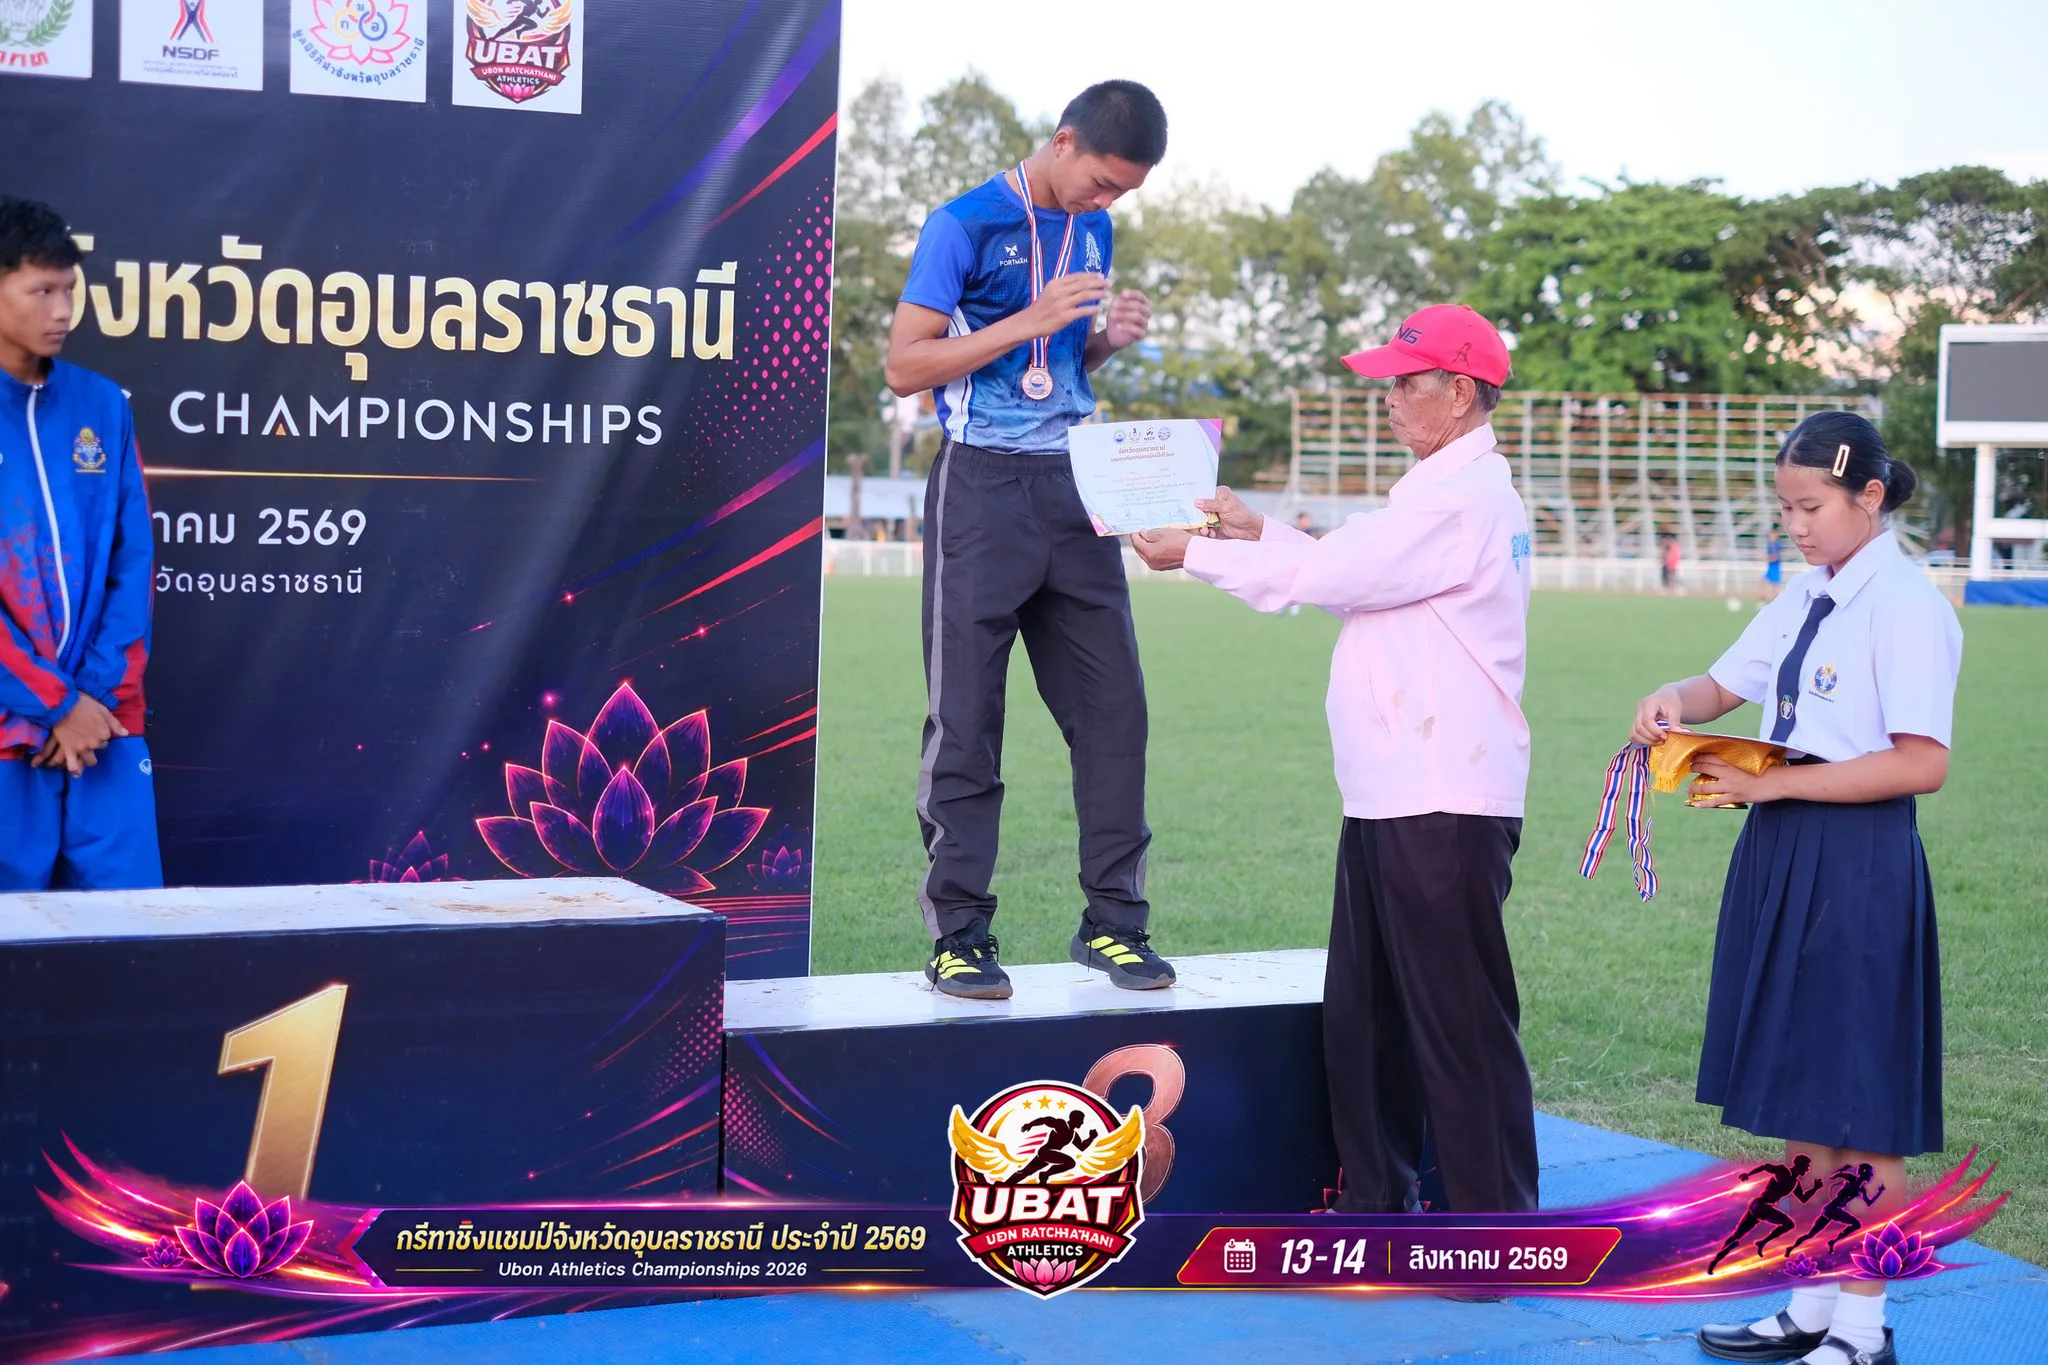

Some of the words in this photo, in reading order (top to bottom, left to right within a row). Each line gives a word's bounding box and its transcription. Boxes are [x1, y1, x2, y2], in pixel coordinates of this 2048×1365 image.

[162, 45, 220, 61] NSDF
[473, 39, 563, 69] UBAT
[481, 67, 504, 76] UBON
[505, 66, 557, 81] RATCHATHANI
[496, 75, 540, 85] ATHLETICS
[169, 390, 663, 446] CHAMPIONSHIPS
[258, 507, 367, 546] 2569
[214, 983, 348, 1210] 1
